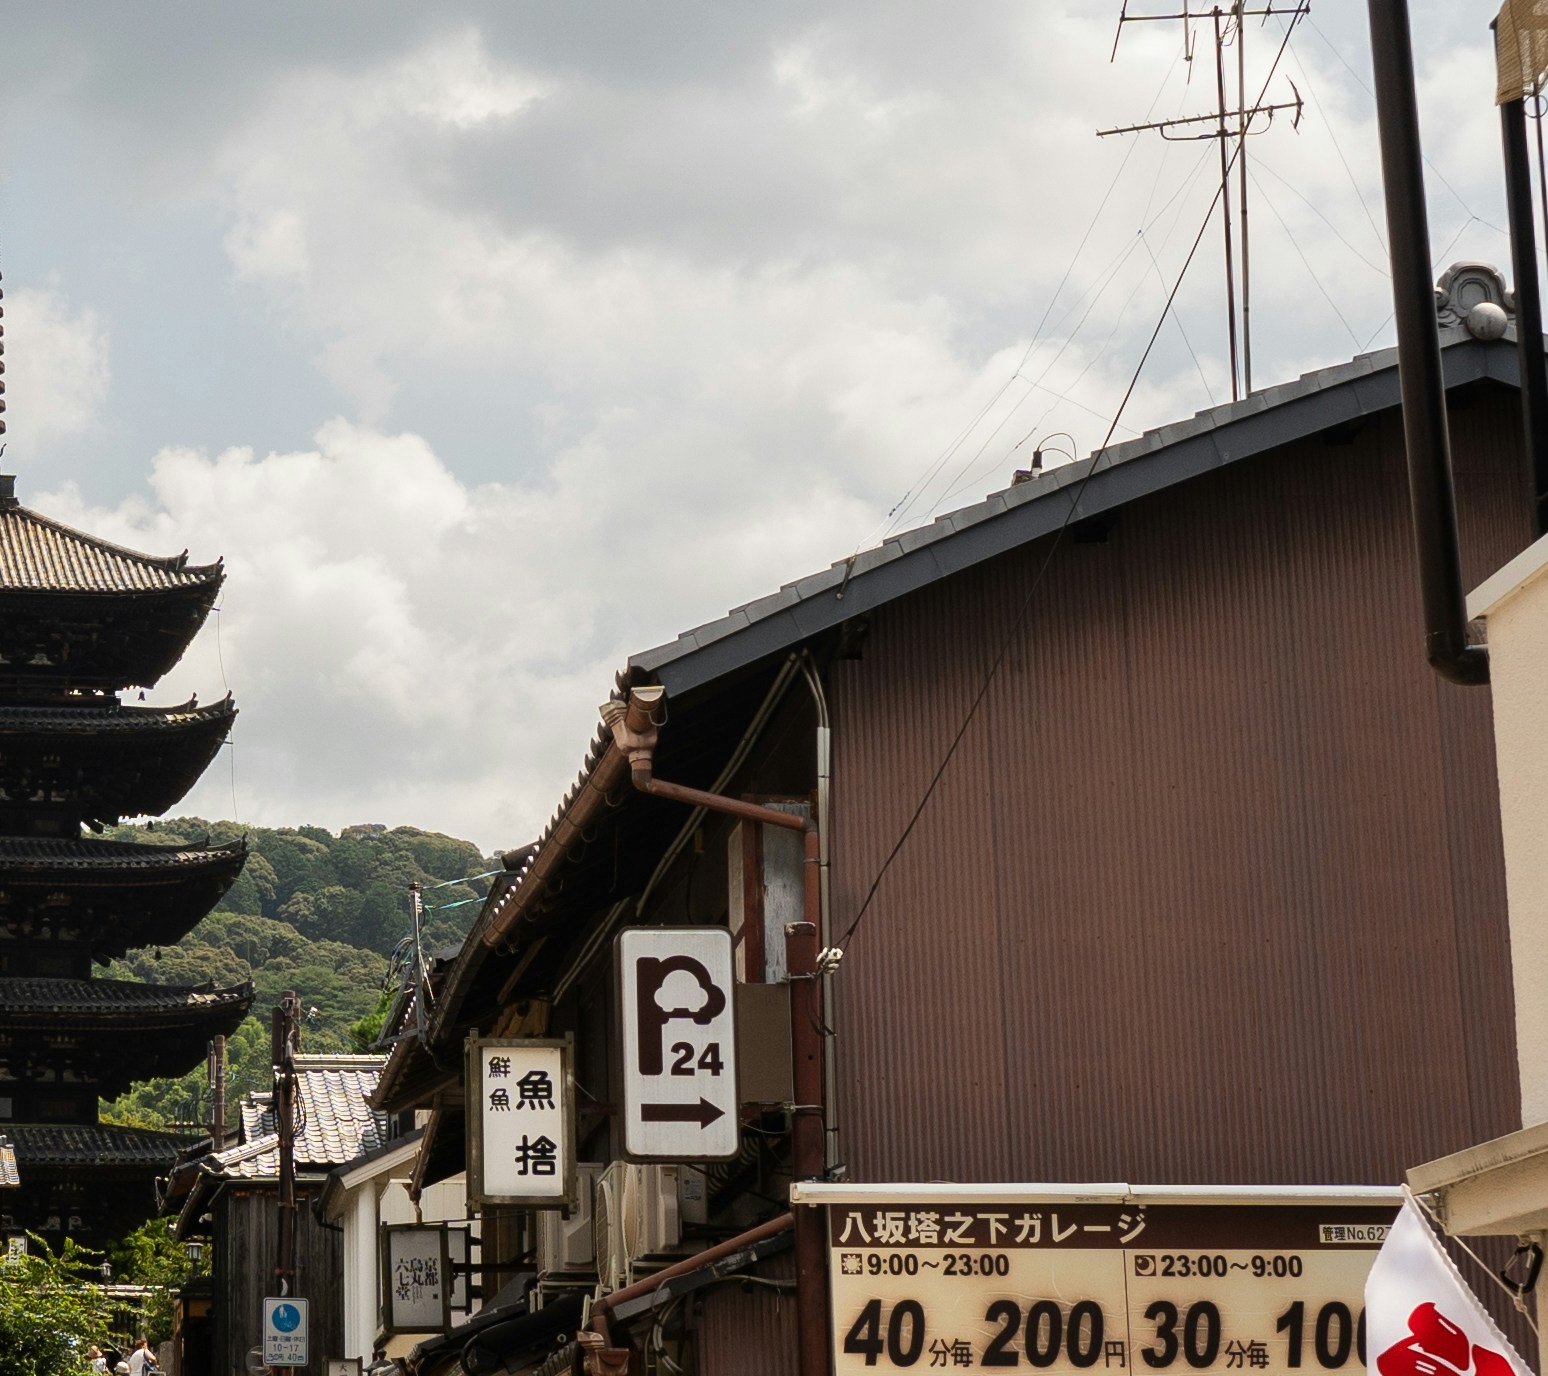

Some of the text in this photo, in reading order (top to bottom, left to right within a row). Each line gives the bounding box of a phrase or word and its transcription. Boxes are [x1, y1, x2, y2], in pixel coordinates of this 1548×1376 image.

[670, 1041, 725, 1078] 24
[488, 1056, 512, 1113] 鮮魚
[514, 1070, 557, 1177] 魚捨
[839, 1211, 1147, 1245] 八坂塔之下ガレージ
[395, 1257, 411, 1301] 六七堂
[424, 1257, 439, 1286] 京都
